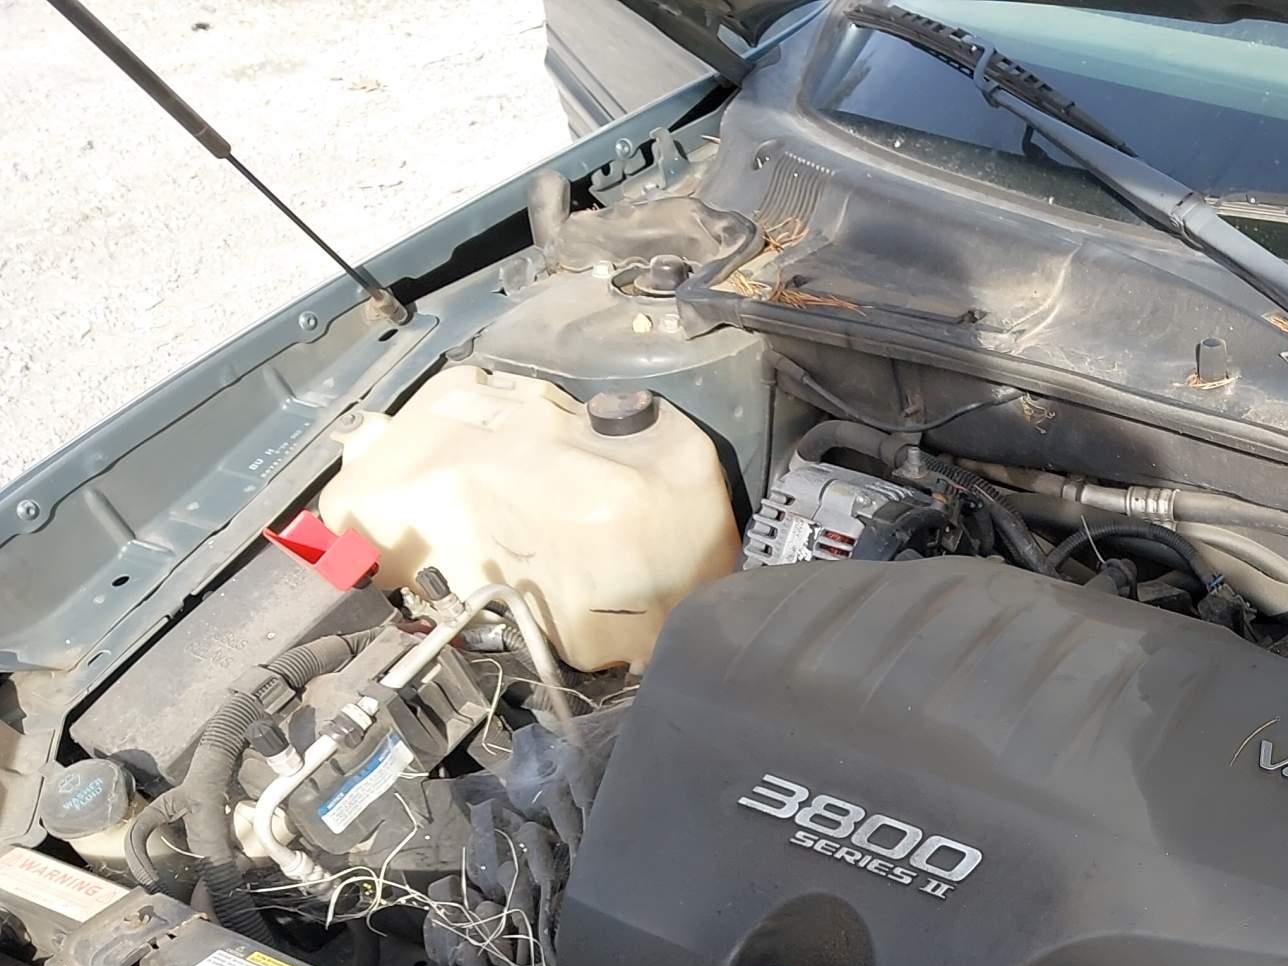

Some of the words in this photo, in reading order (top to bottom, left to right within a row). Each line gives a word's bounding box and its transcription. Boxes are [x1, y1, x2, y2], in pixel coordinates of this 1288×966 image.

[737, 773, 983, 882] 3800
[18, 858, 104, 897] WARNING
[789, 830, 918, 885] SERIES
[918, 877, 956, 900] II
